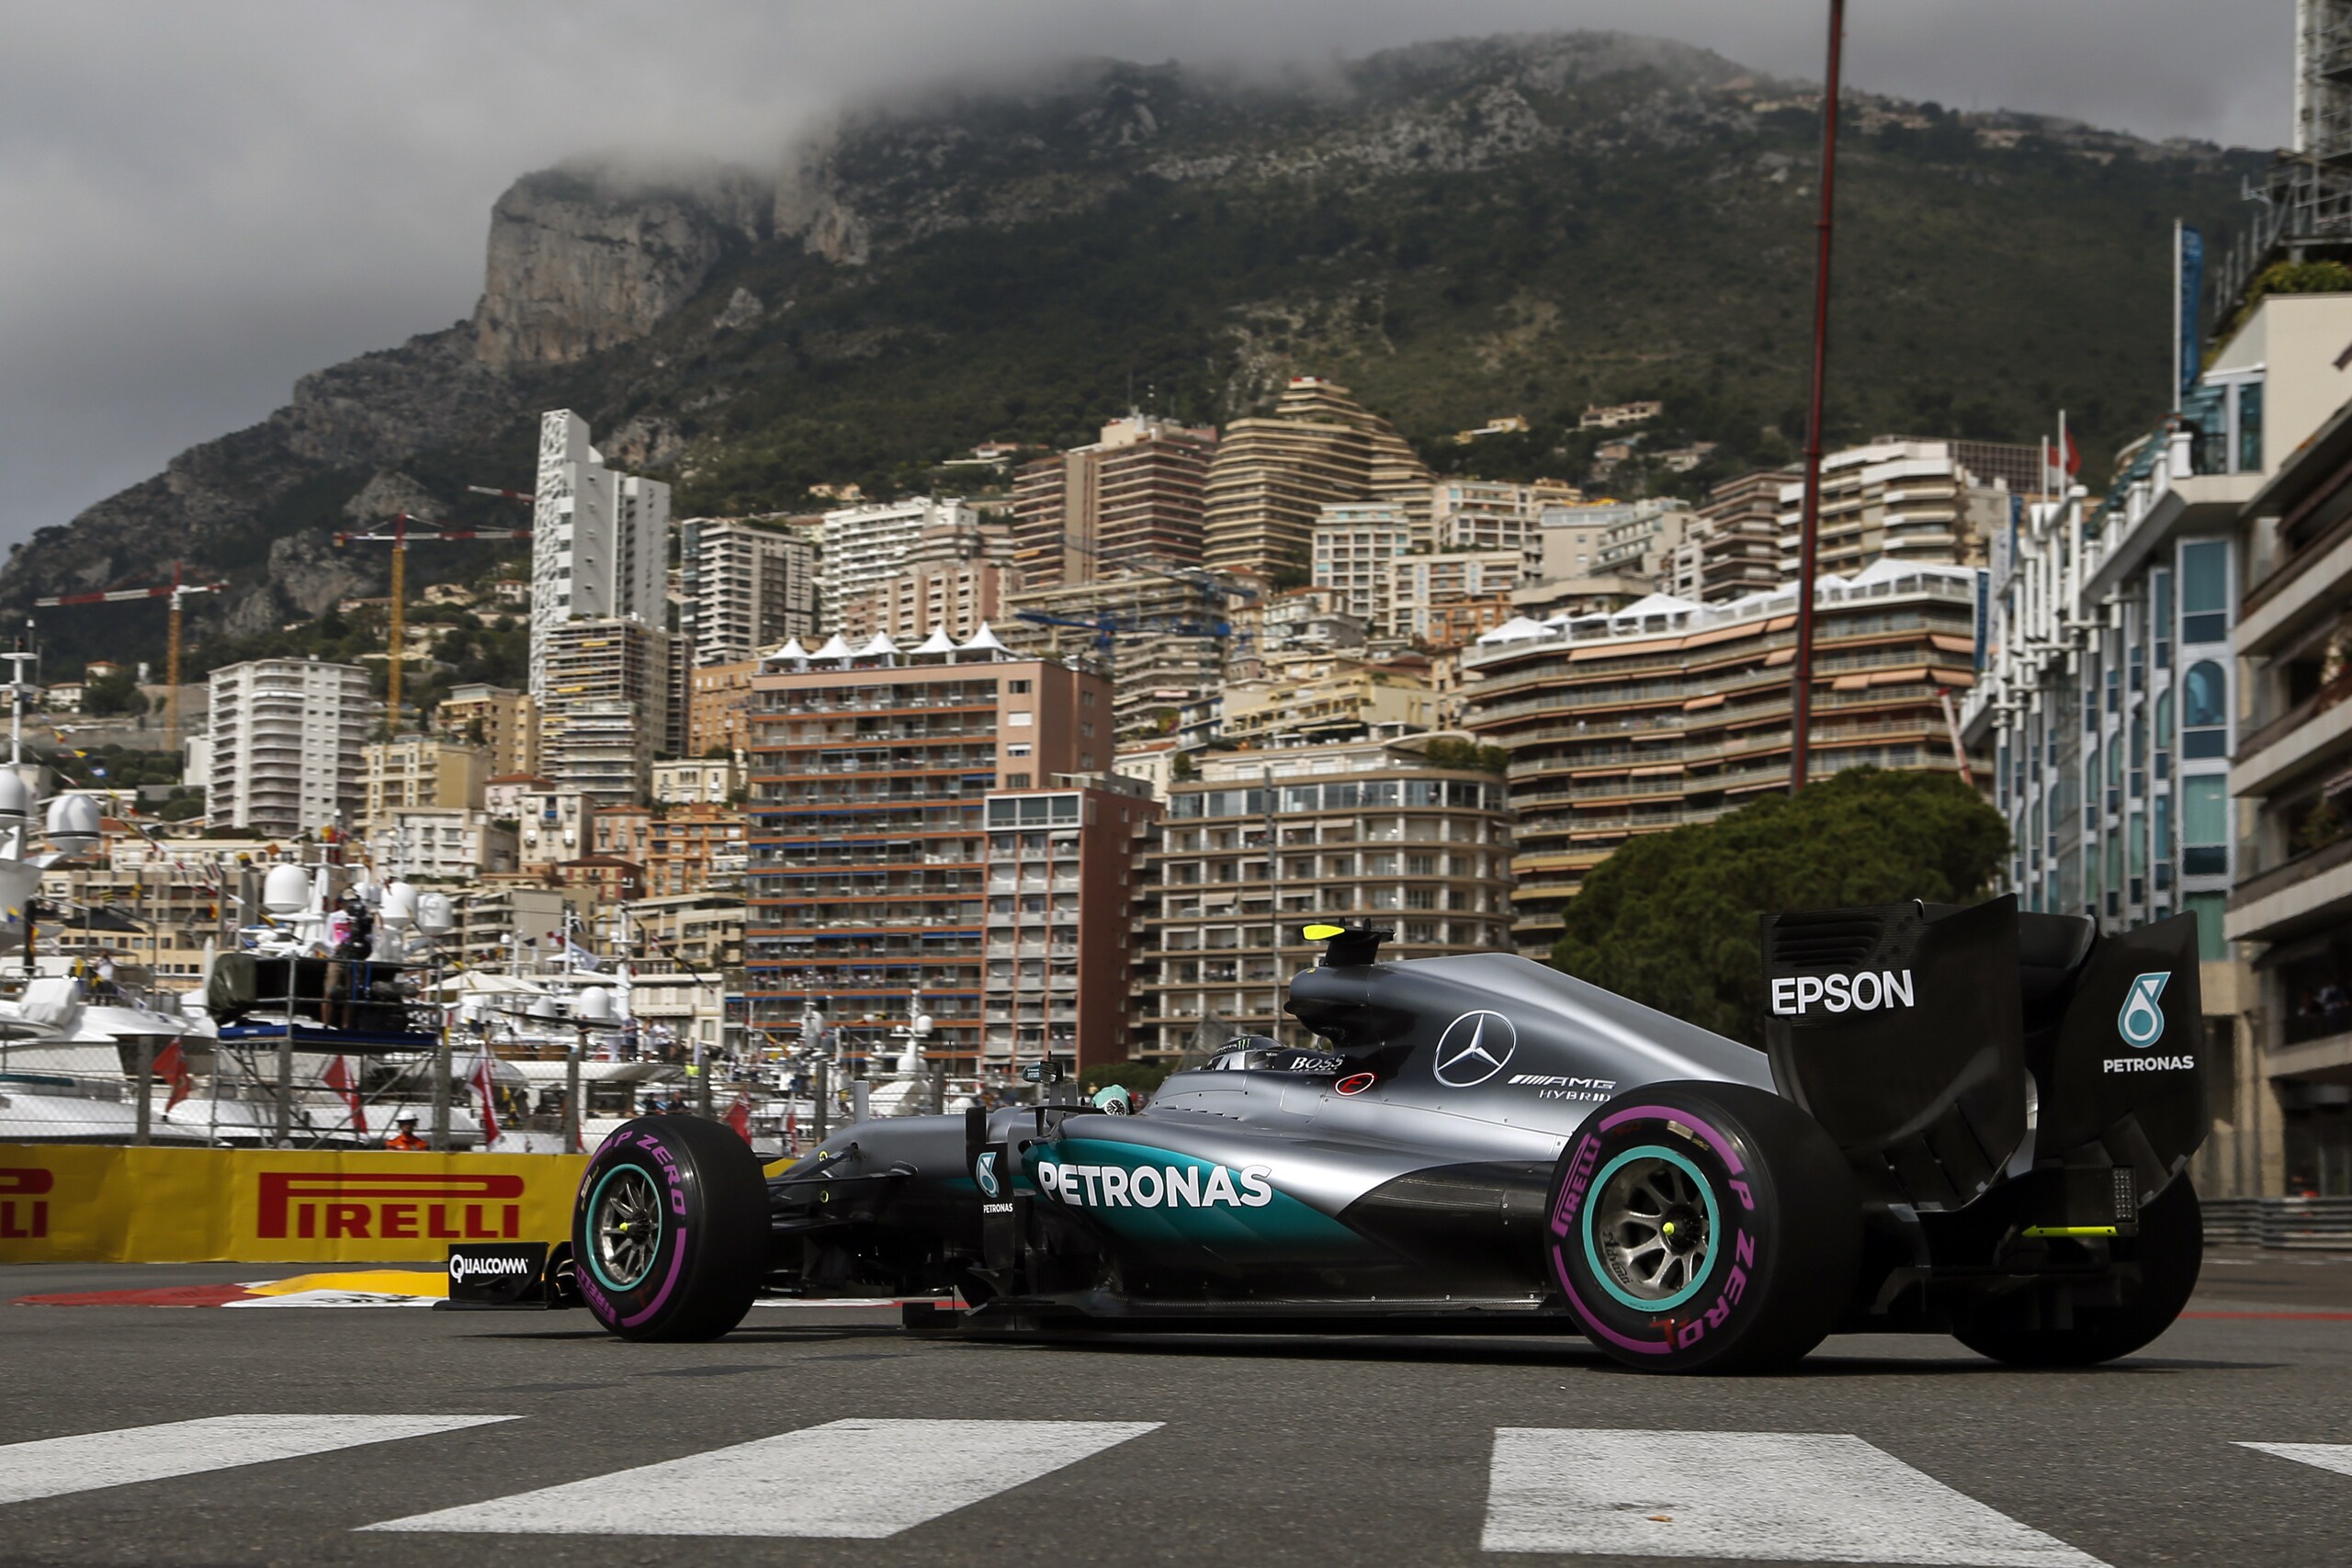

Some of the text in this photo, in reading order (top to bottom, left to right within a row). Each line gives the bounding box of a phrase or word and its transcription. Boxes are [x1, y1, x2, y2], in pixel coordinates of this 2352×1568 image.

[1770, 969, 1915, 1015] EPSON
[1289, 1054, 1346, 1070] BOSS
[2103, 1055, 2195, 1074] PETRONAS
[1539, 1089, 1611, 1102] HYBRID
[614, 1131, 633, 1147] P
[636, 1134, 686, 1215] ZERO
[1037, 1161, 1272, 1208] PETRONAS
[1551, 1132, 1602, 1238] PIRELLI
[257, 1172, 525, 1239] PIRELLI
[982, 1202, 1013, 1213] PETRONAS
[449, 1254, 528, 1283] QUALCOMM
[1678, 1179, 1755, 1349] P ZERO
[576, 1264, 616, 1325] PIRELLI
